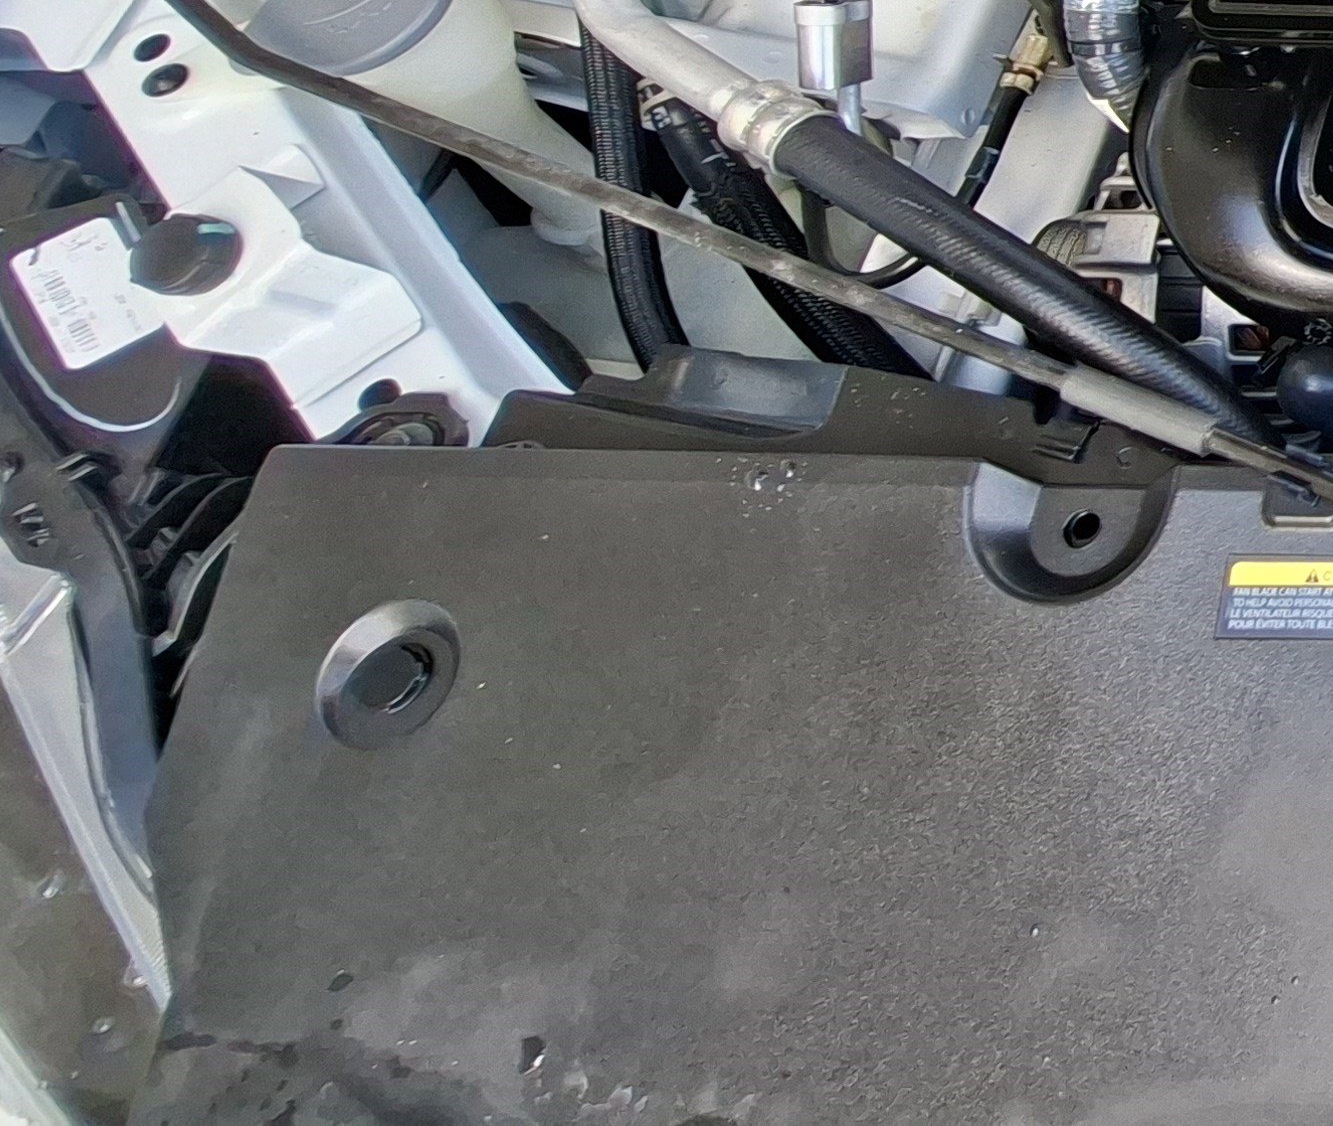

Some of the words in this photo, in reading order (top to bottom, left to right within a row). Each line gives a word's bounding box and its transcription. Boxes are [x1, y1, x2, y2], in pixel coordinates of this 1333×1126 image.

[1246, 598, 1266, 607] HELP
[1227, 619, 1254, 629] POUR
[1287, 619, 1316, 629] TOUTE
